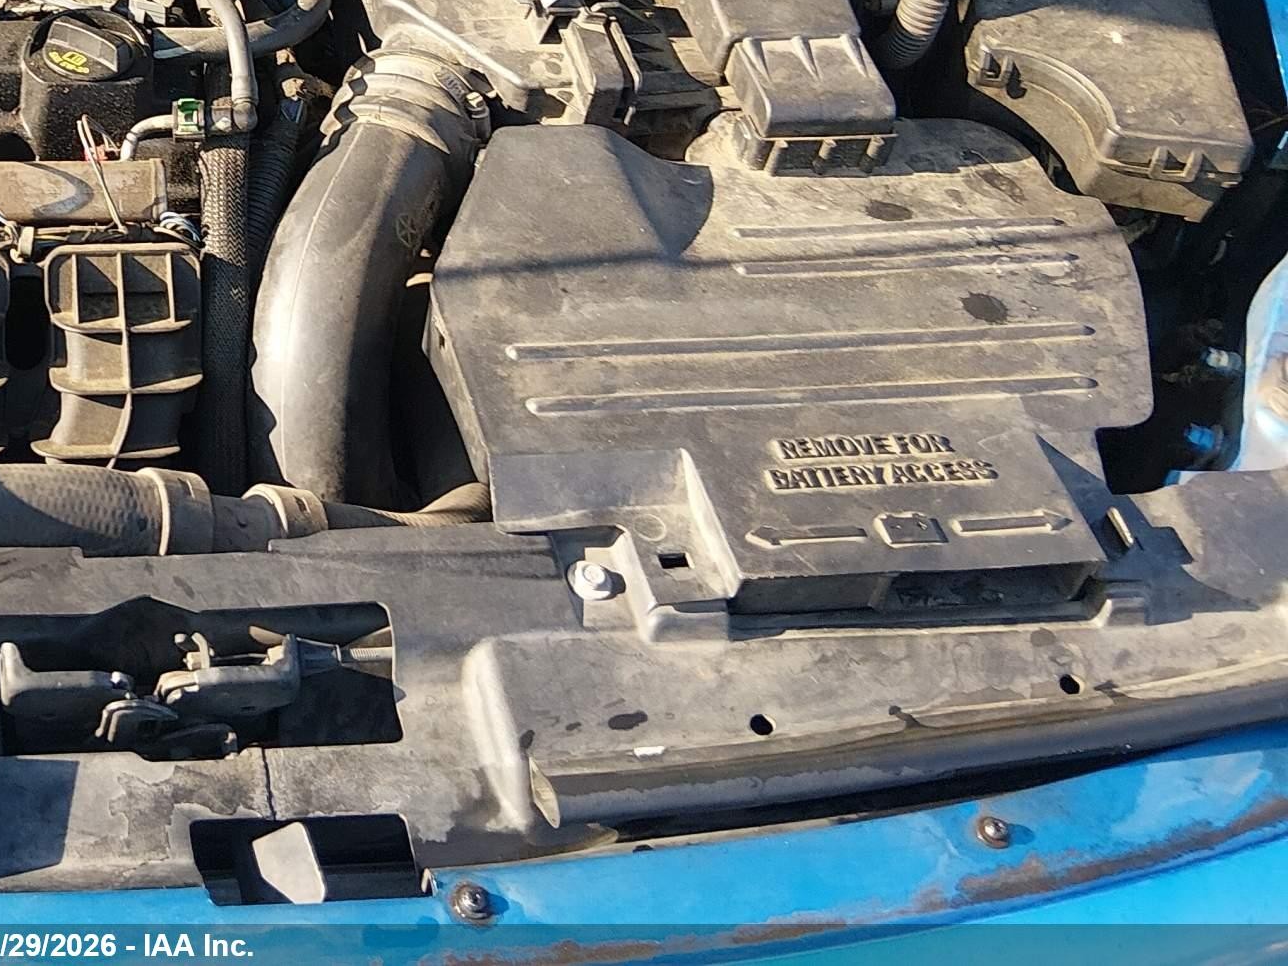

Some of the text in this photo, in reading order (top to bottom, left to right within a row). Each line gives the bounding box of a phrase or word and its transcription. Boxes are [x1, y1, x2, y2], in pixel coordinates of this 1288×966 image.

[776, 433, 955, 460] REMOVE FOR
[767, 459, 999, 490] BATTERY ACCESS
